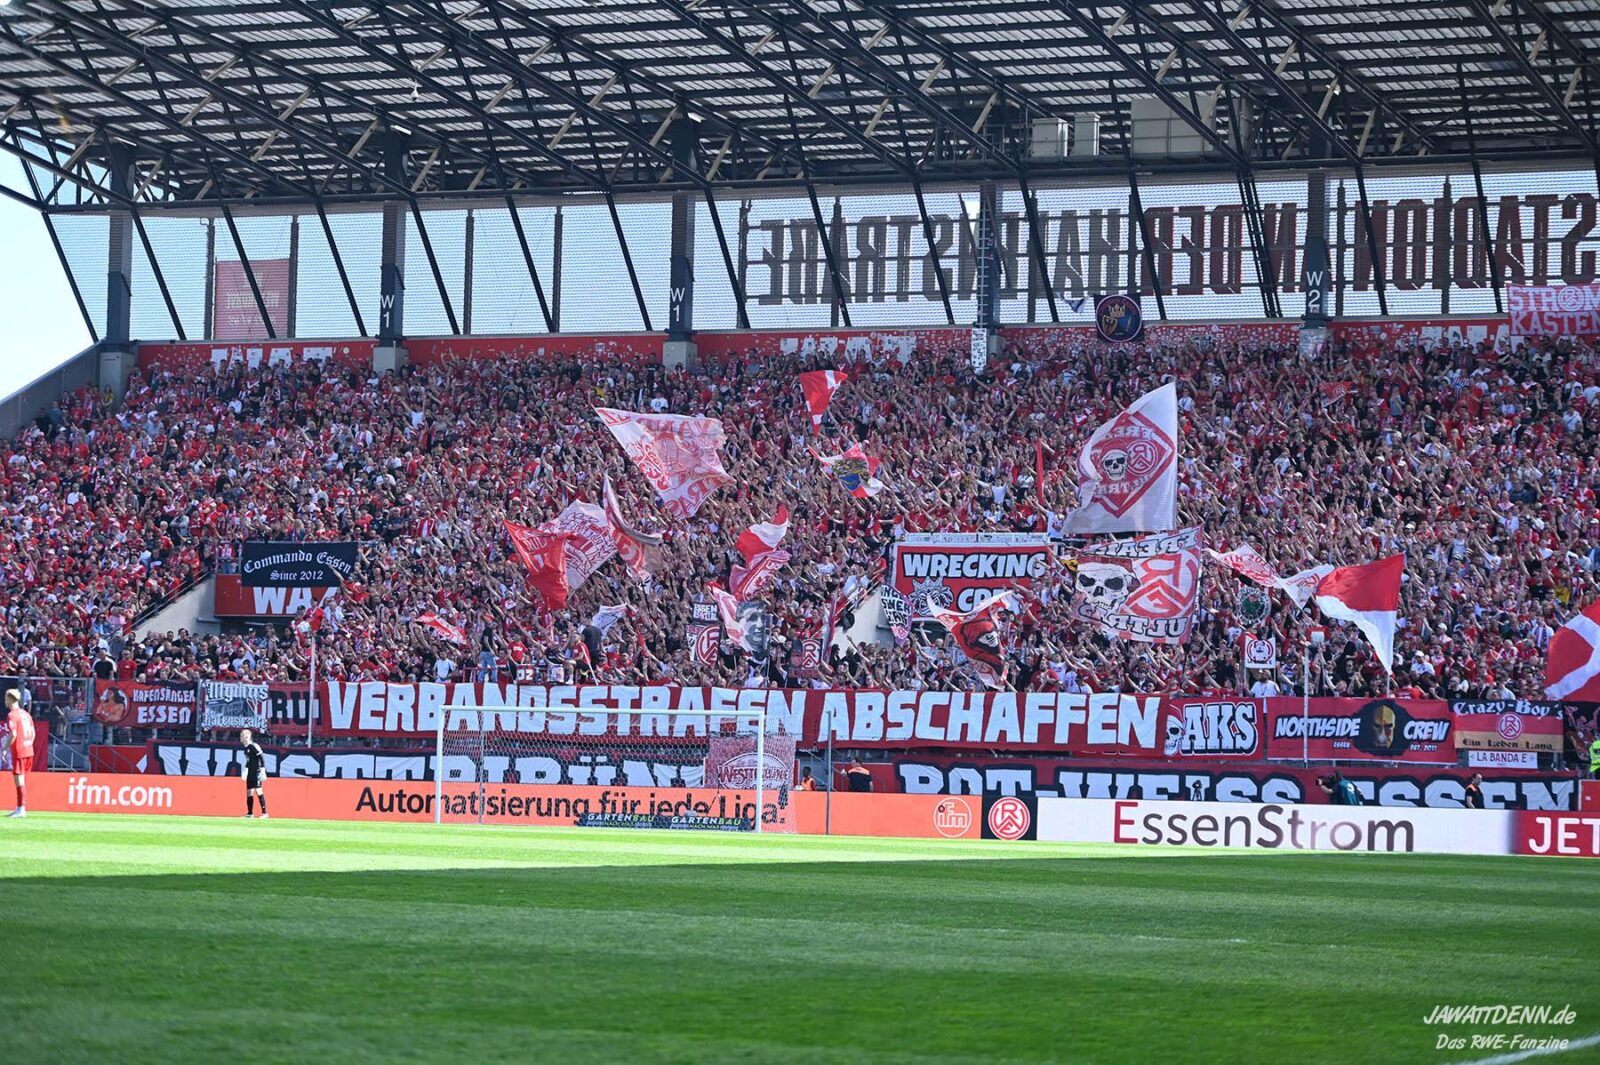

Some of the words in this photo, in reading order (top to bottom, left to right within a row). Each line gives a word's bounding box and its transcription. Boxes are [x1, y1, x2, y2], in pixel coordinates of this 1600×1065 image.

[244, 550, 313, 573] Commando
[317, 551, 352, 575] Essen
[270, 570, 297, 580] Since
[300, 571, 324, 580] 2012
[903, 553, 1047, 578] WRECKING
[138, 705, 191, 723] ESSEN
[328, 681, 807, 741] VERBANDSSTRAFEN
[818, 691, 1161, 749] ABSCHAFFEN
[1182, 703, 1257, 754] AKS
[1275, 716, 1361, 738] NORTHSIDE
[1403, 721, 1450, 741] CREW
[1477, 752, 1487, 761] LA
[1490, 753, 1518, 762] BANDA
[1521, 753, 1528, 763] E
[68, 777, 172, 807] ifm.com
[356, 787, 590, 826] Automatisierung
[599, 791, 641, 816] für
[648, 793, 710, 817] jede
[587, 813, 654, 823] GARTENBAU
[672, 816, 741, 826] GARTENBAU
[1114, 801, 1414, 852] EssenStrom
